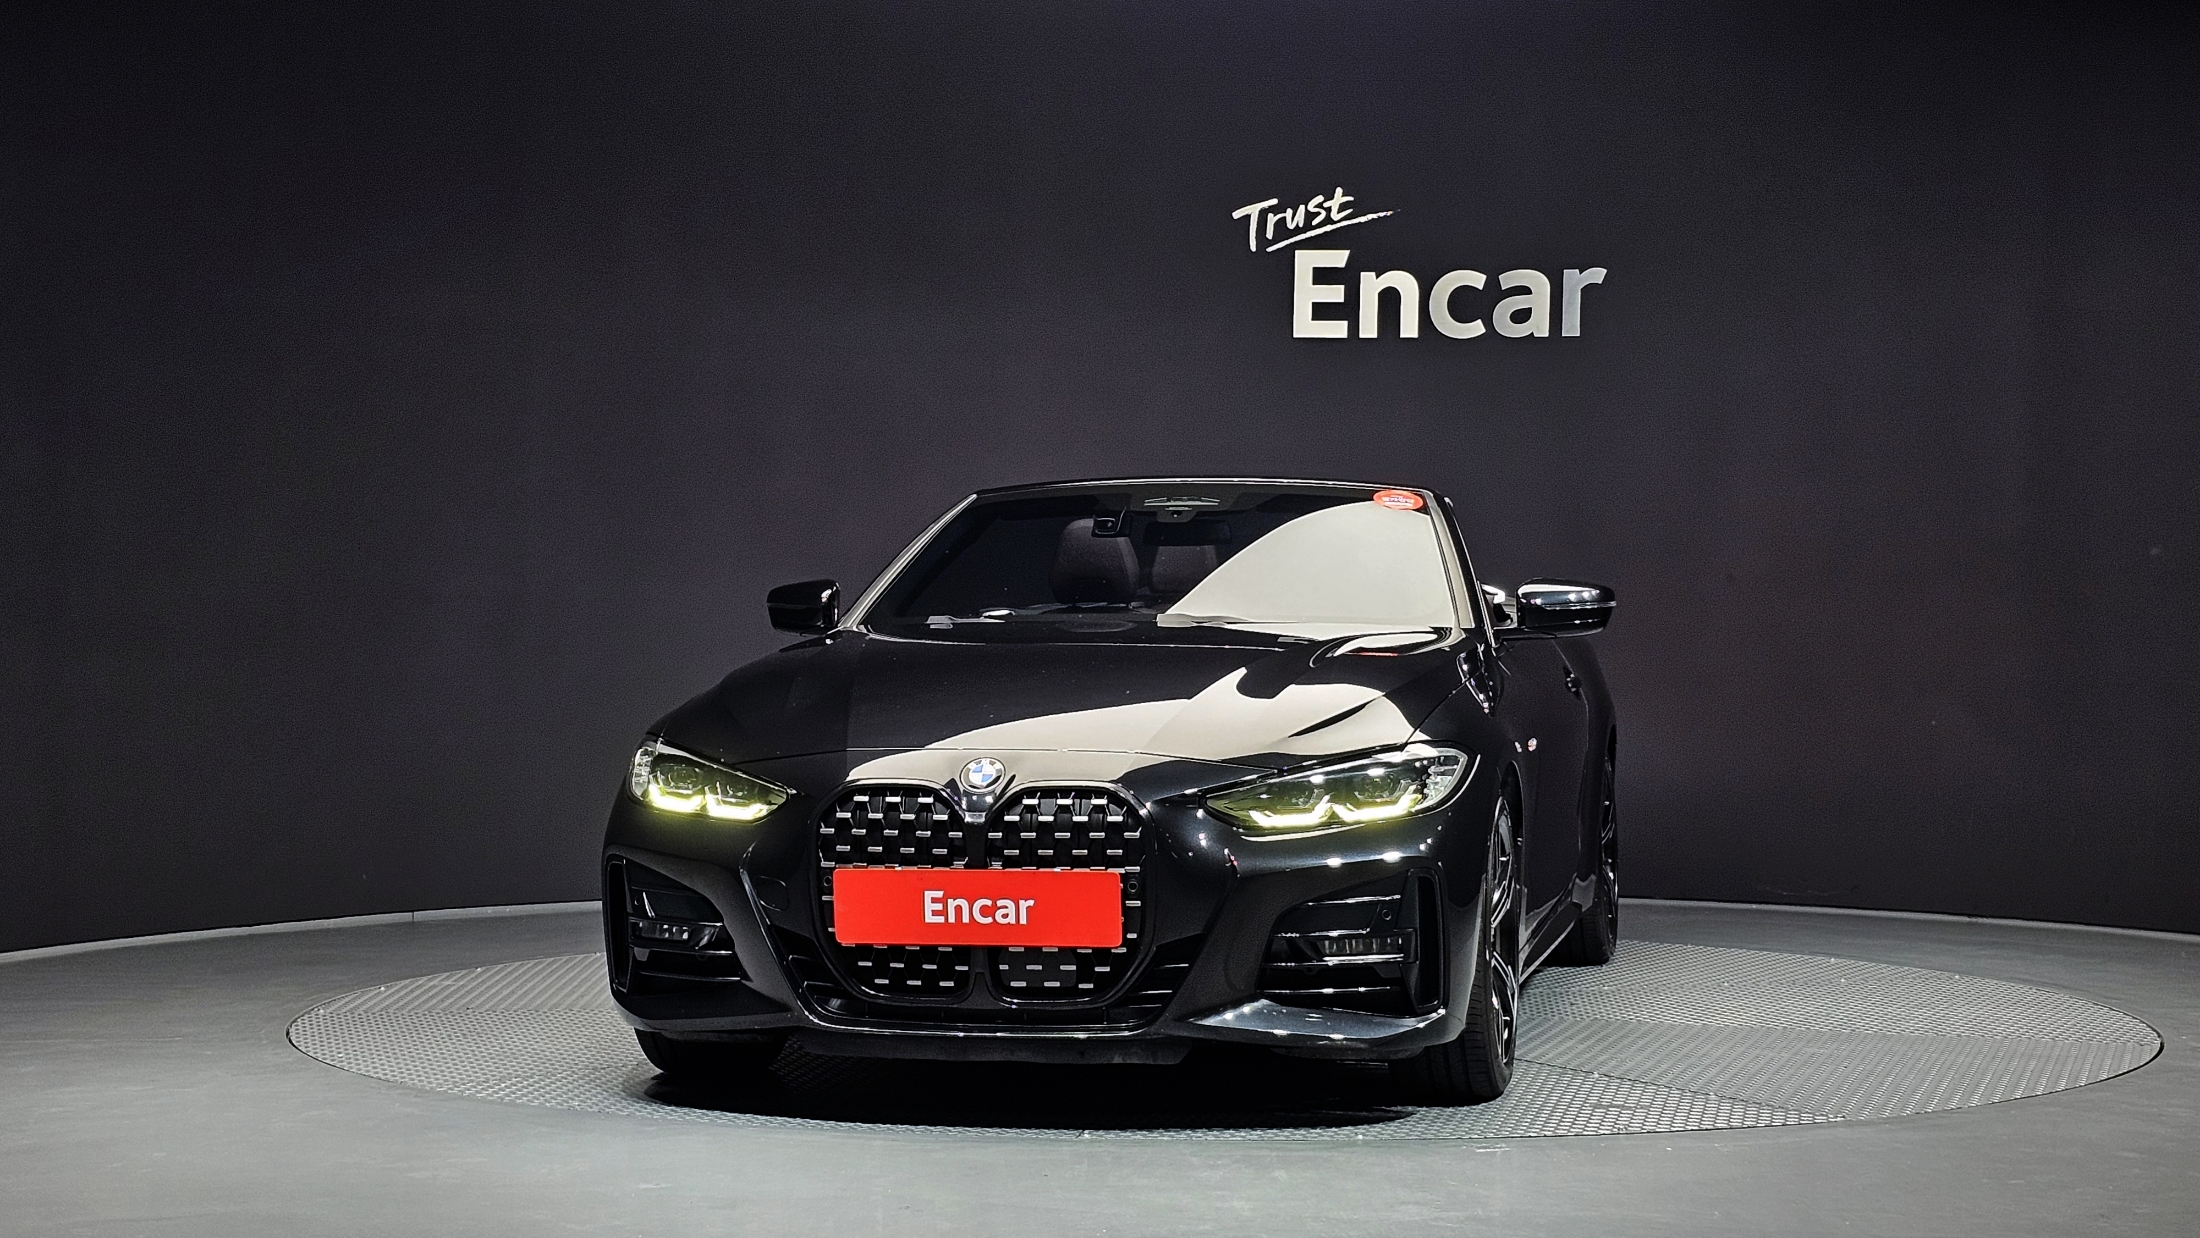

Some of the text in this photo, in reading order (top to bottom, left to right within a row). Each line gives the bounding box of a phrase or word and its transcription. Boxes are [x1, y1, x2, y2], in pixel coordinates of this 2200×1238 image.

[1231, 186, 1355, 253] Trust
[1292, 249, 1608, 340] Encar
[923, 890, 1036, 925] Encar
